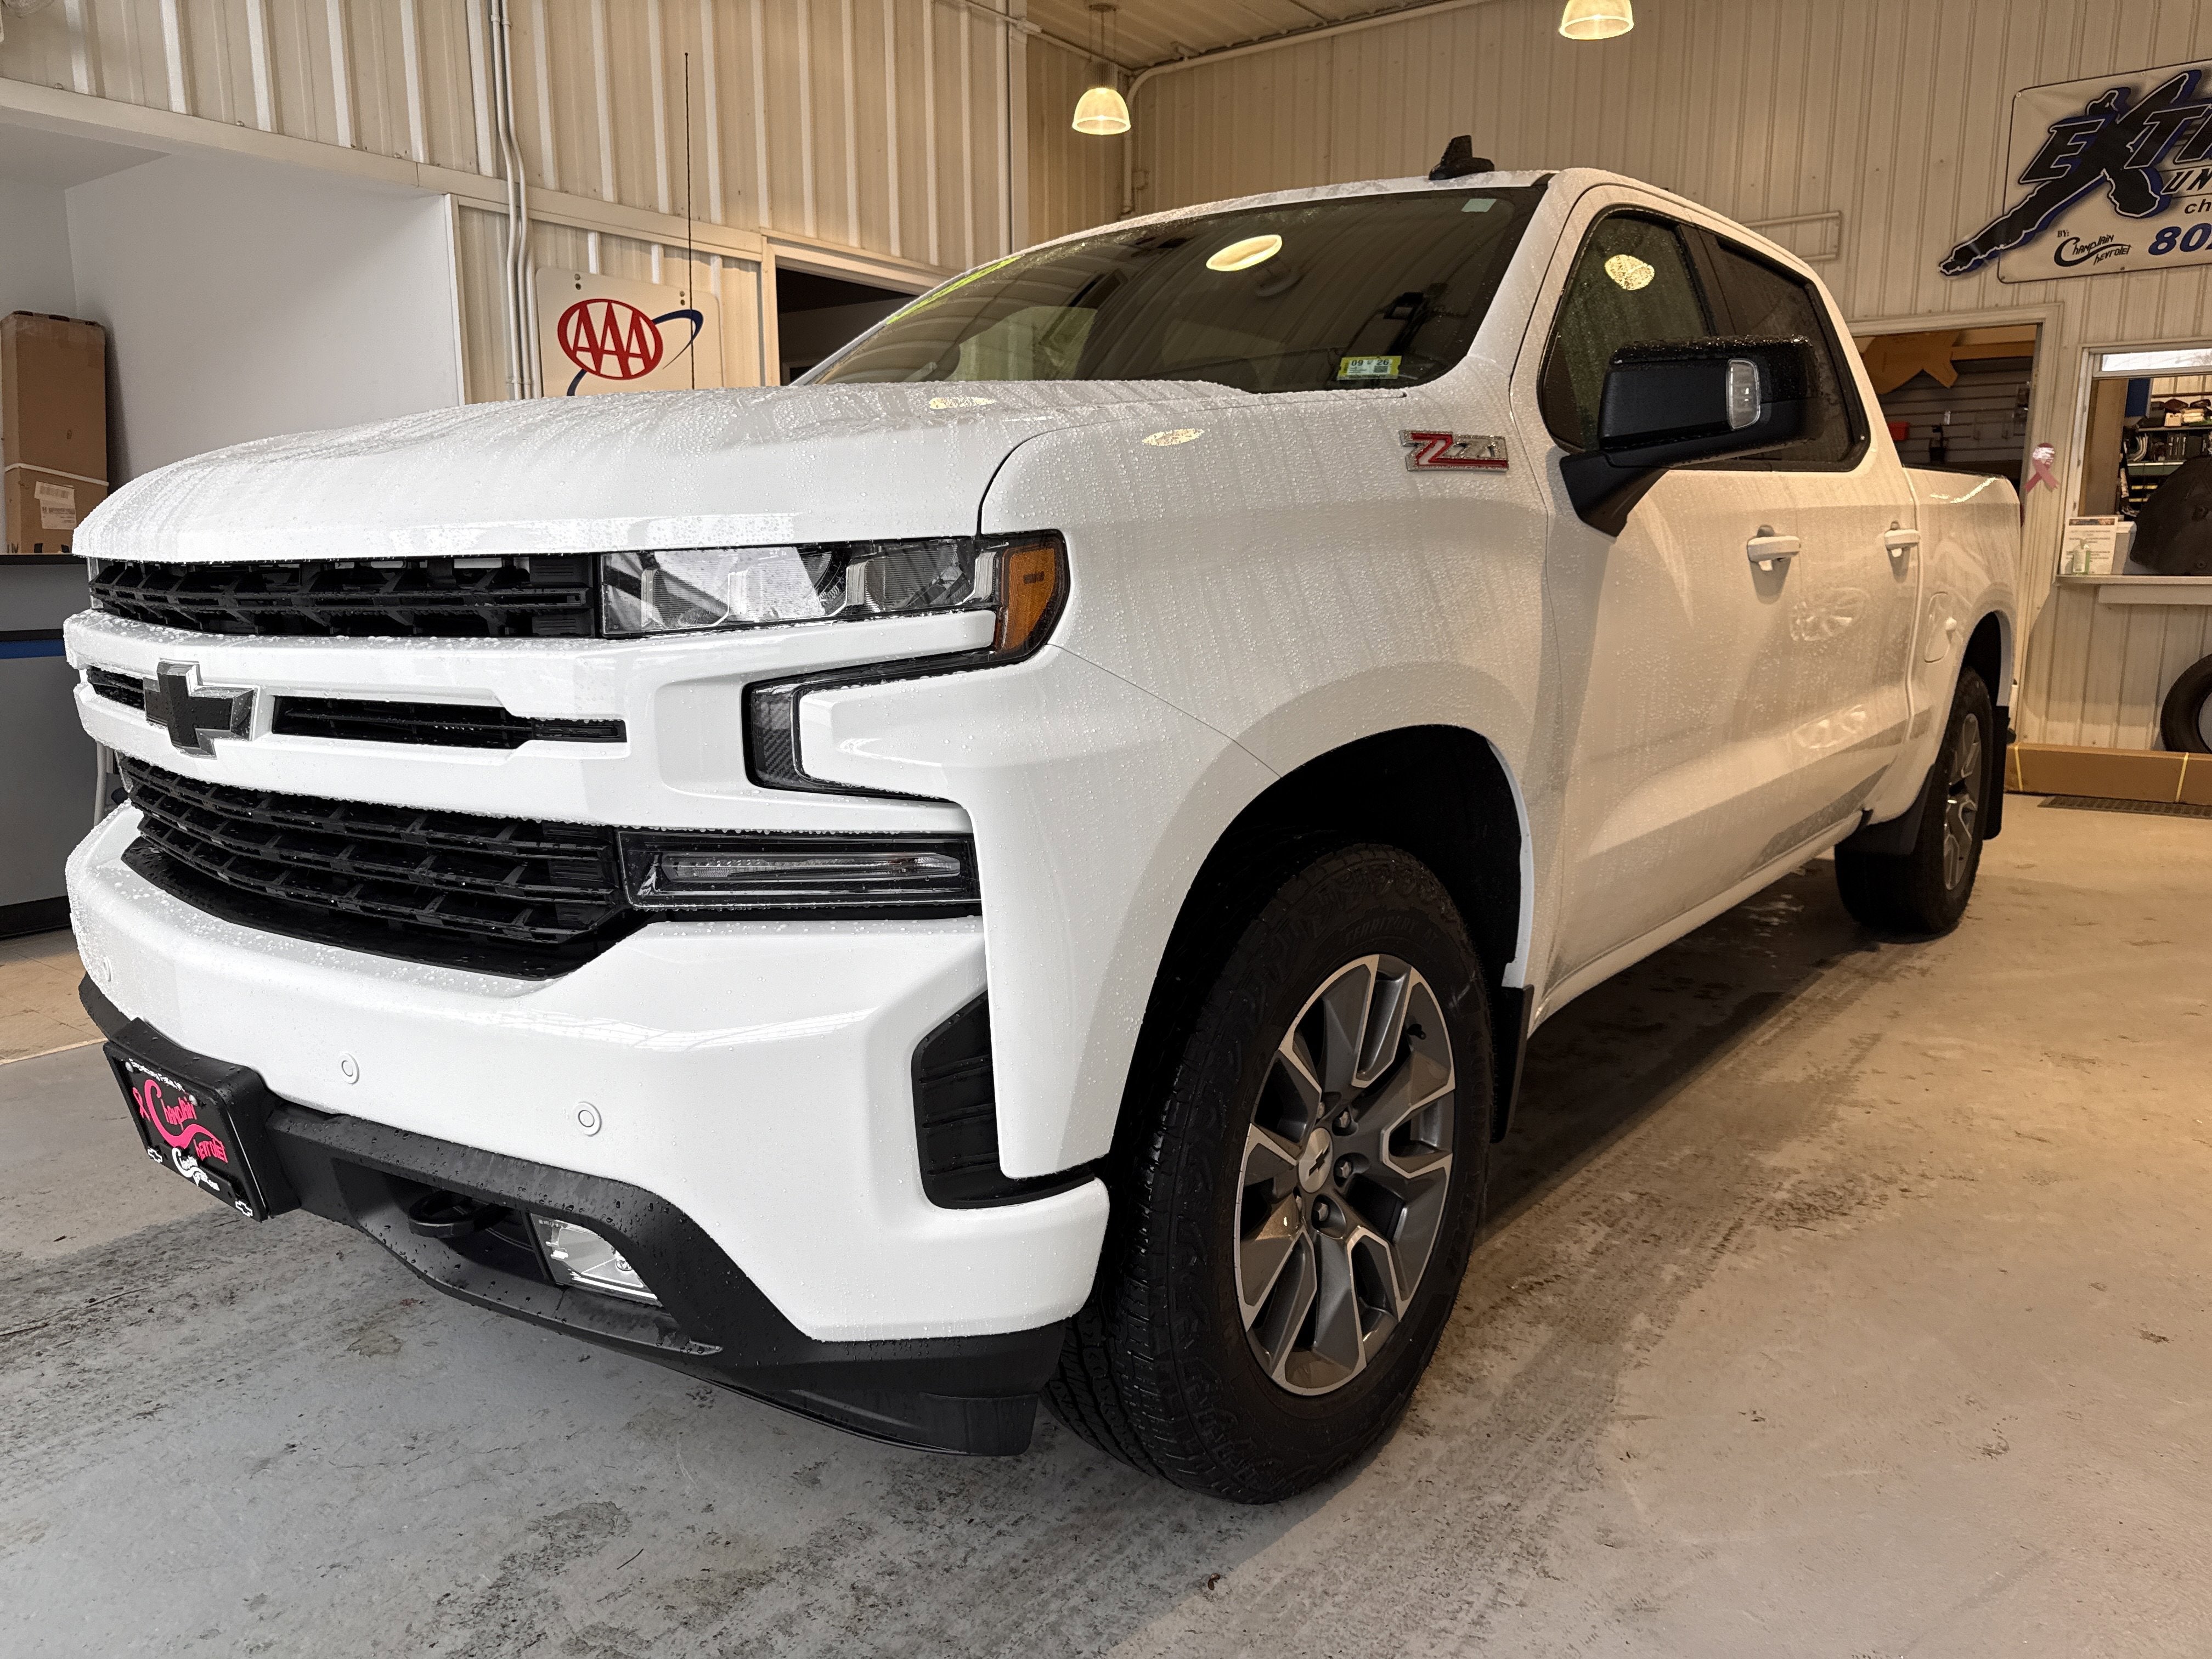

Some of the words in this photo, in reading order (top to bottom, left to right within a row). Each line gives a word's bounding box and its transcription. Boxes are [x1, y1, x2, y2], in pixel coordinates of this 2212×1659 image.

[2148, 222, 2212, 256] 80
[569, 299, 658, 379] AAA
[1399, 430, 1509, 472] Z71
[1345, 916, 1420, 947] TERRITORY
